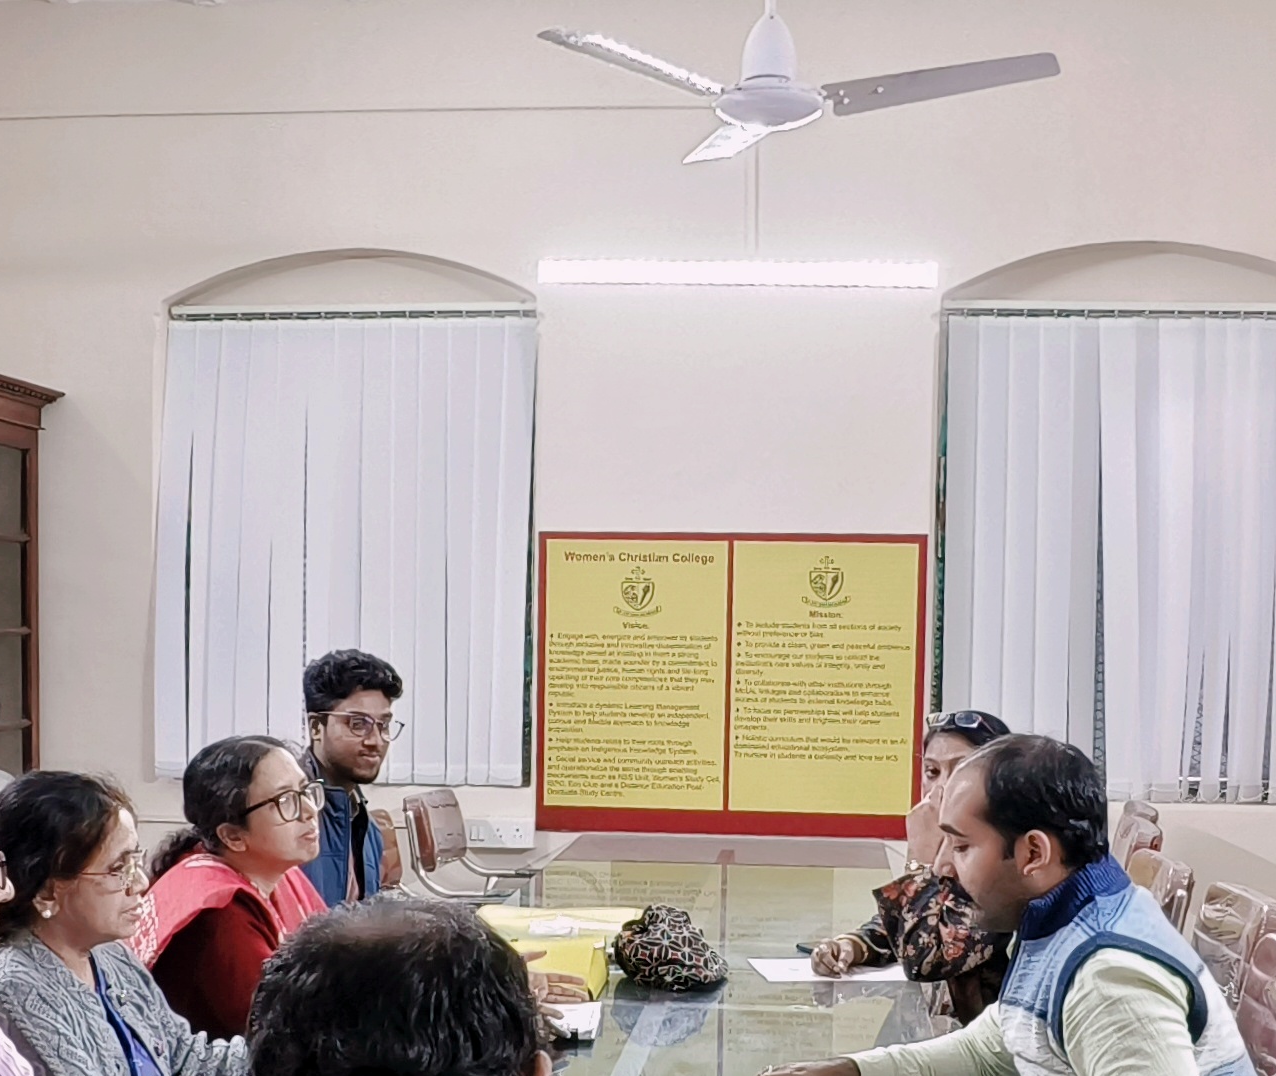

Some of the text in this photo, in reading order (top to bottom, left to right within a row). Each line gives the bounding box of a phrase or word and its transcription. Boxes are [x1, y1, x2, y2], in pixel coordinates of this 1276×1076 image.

[564, 551, 715, 565] Women's Christian College
